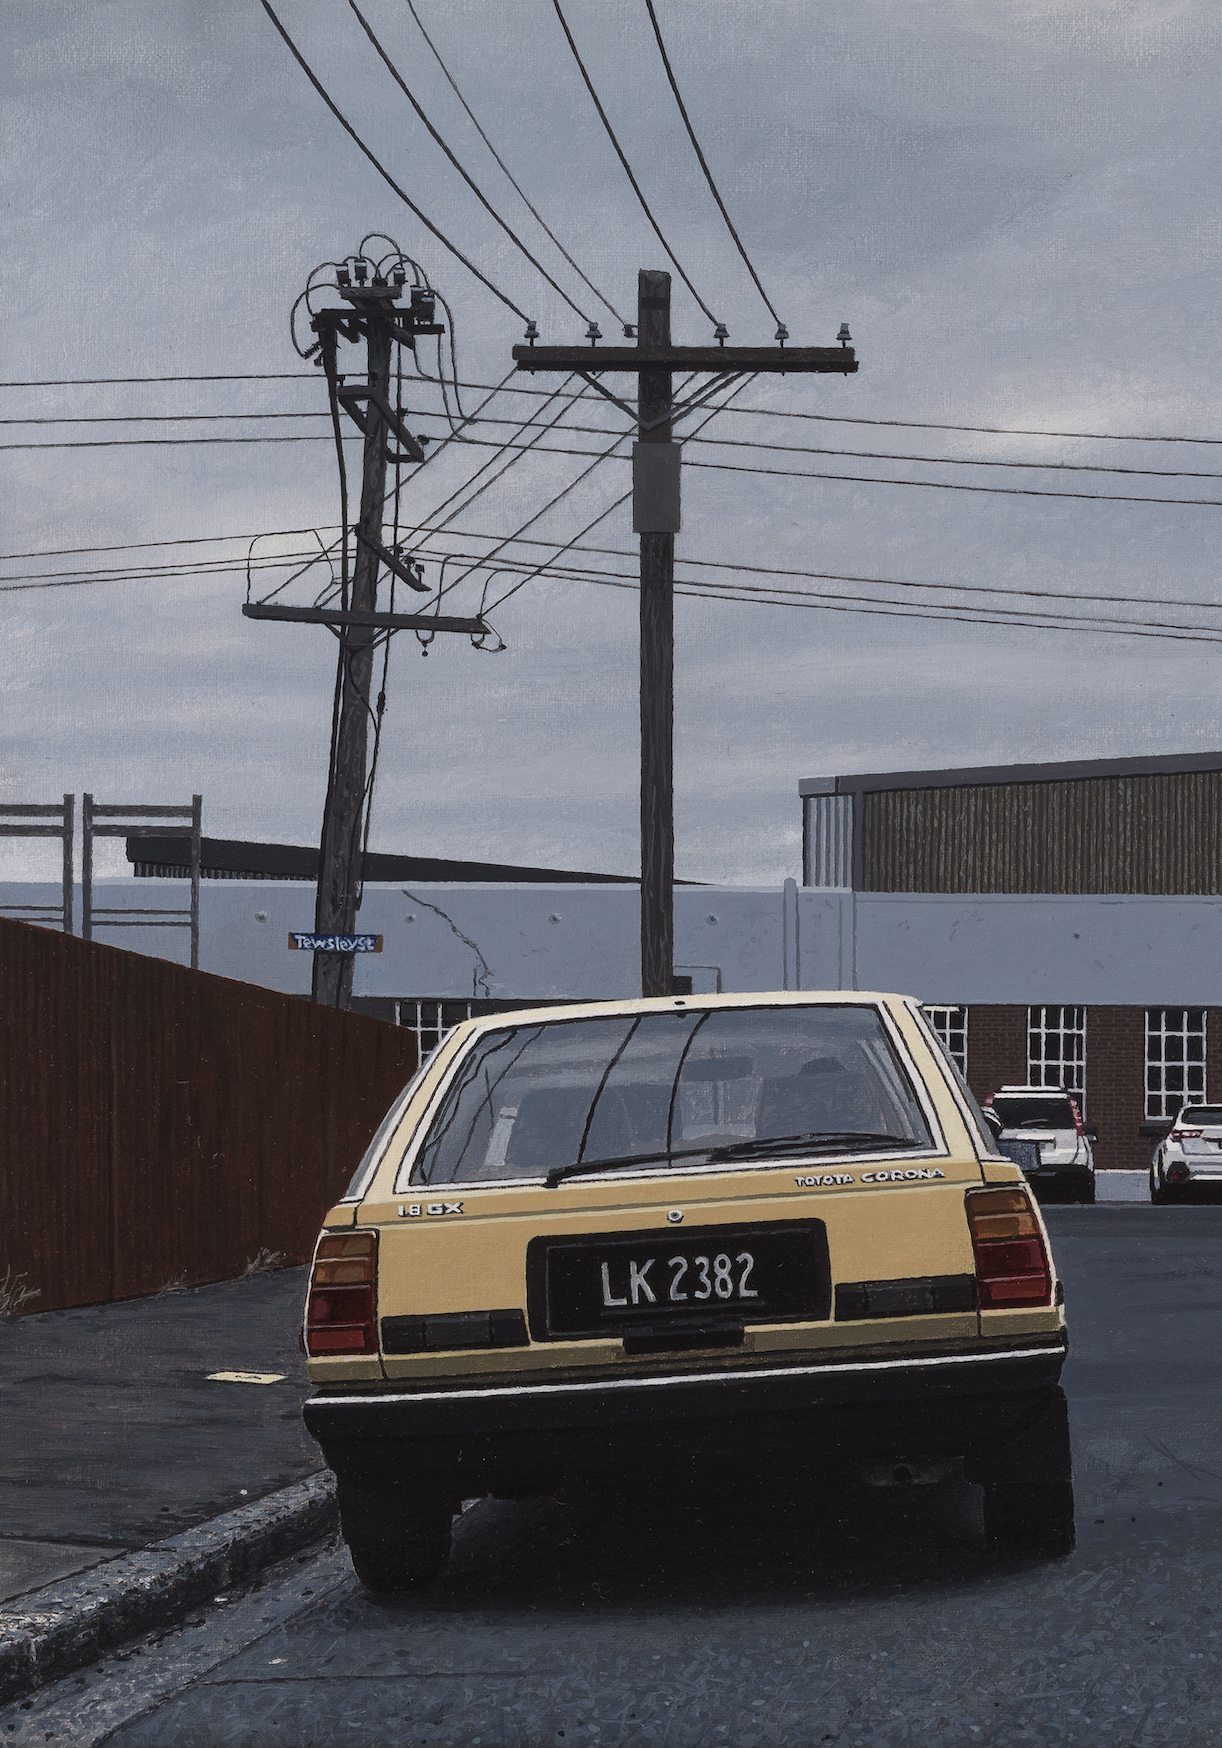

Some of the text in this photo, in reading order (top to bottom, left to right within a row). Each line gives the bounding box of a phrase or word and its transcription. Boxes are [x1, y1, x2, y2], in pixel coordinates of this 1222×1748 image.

[794, 1168, 946, 1187] TOYOTA CORONA
[426, 1202, 464, 1216] GX
[601, 1252, 759, 1306] LK 2382
